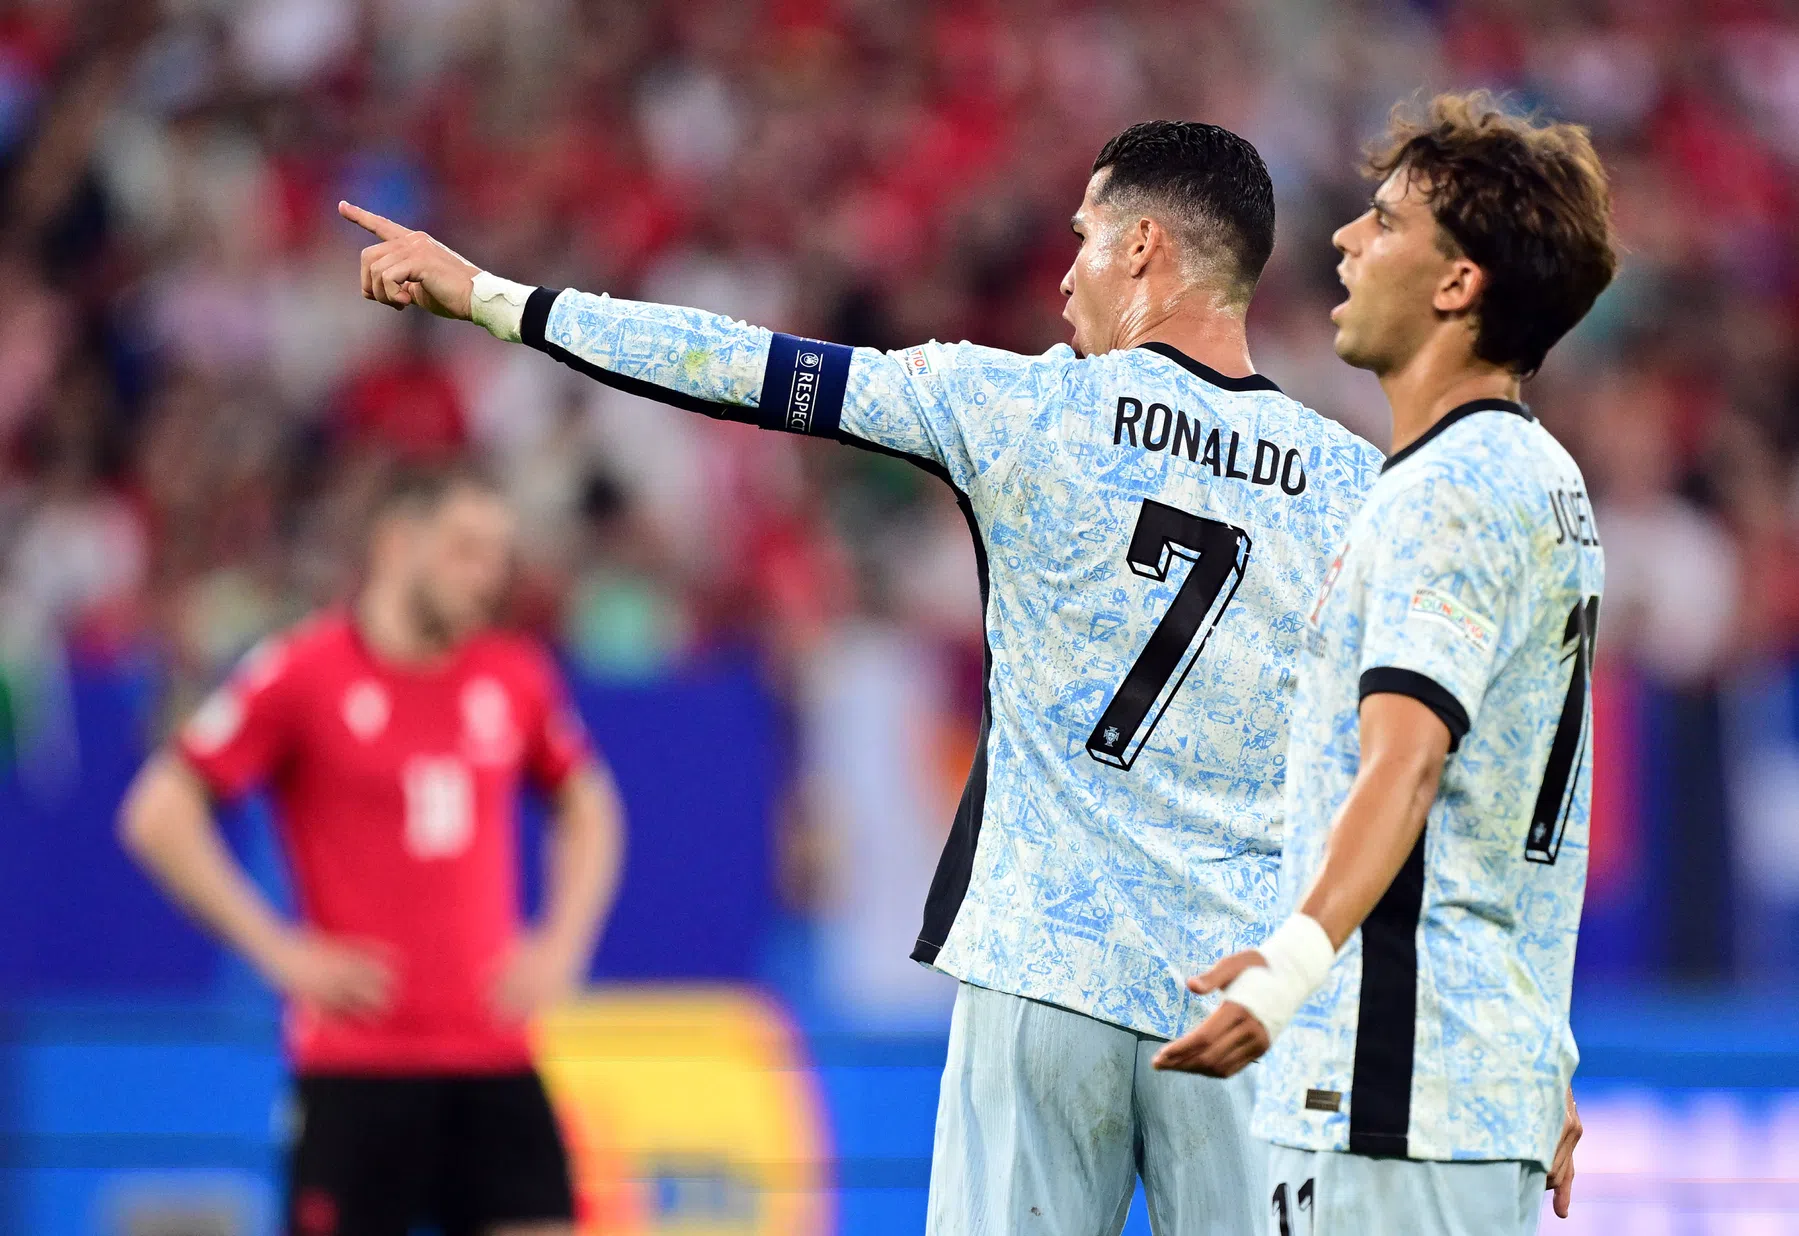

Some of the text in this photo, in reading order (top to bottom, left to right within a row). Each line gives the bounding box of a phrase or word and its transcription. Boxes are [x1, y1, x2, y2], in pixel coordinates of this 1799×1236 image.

[791, 372, 815, 432] RESPECT
[1113, 396, 1307, 497] RONALDO
[1085, 497, 1253, 773] 7
